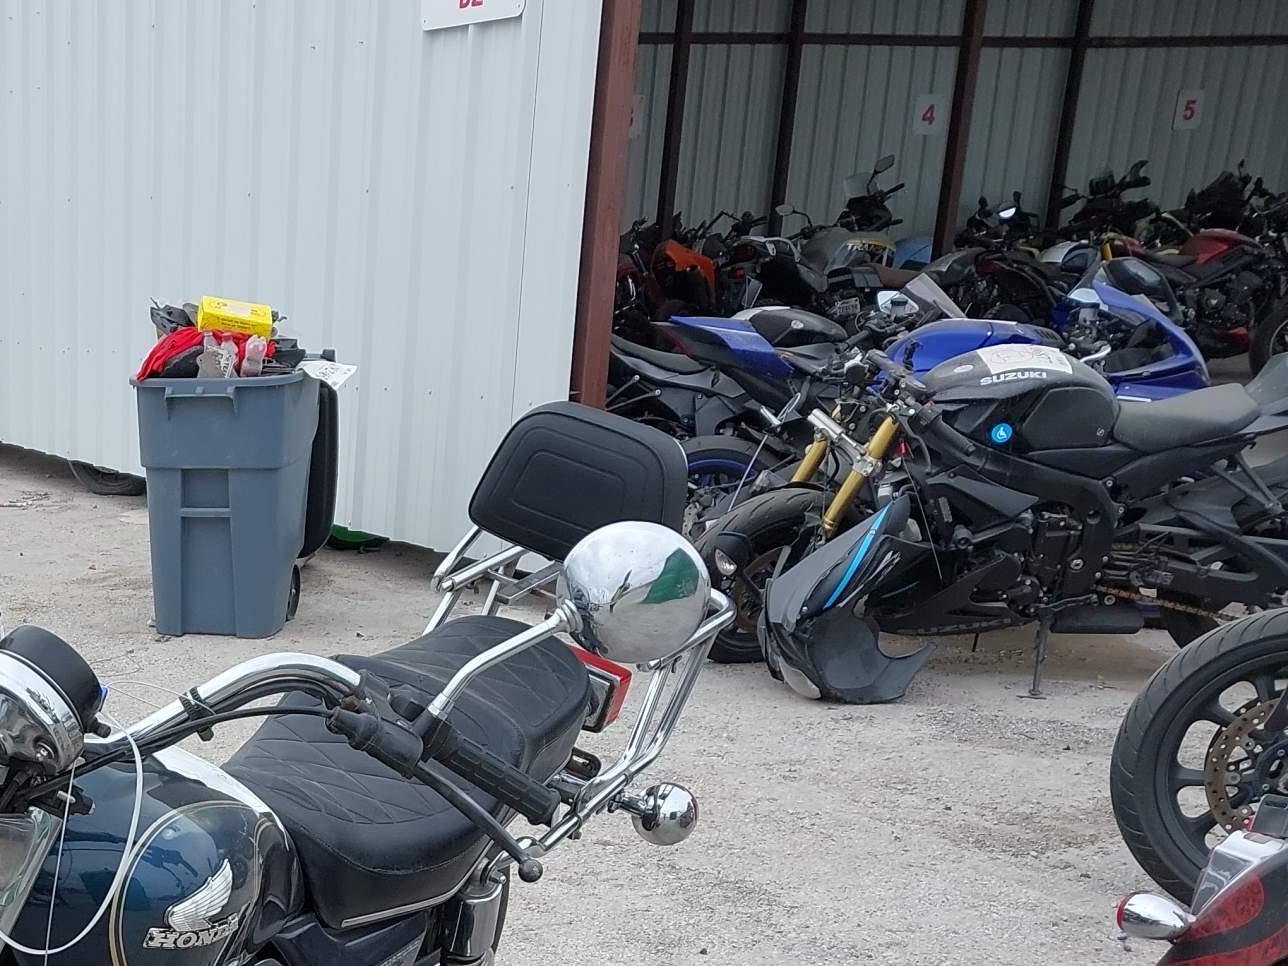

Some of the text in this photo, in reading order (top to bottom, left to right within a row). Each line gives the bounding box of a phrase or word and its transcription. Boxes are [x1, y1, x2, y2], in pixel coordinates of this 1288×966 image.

[922, 104, 935, 125] 4
[1184, 100, 1196, 120] 5
[980, 371, 1047, 385] SUZUKI
